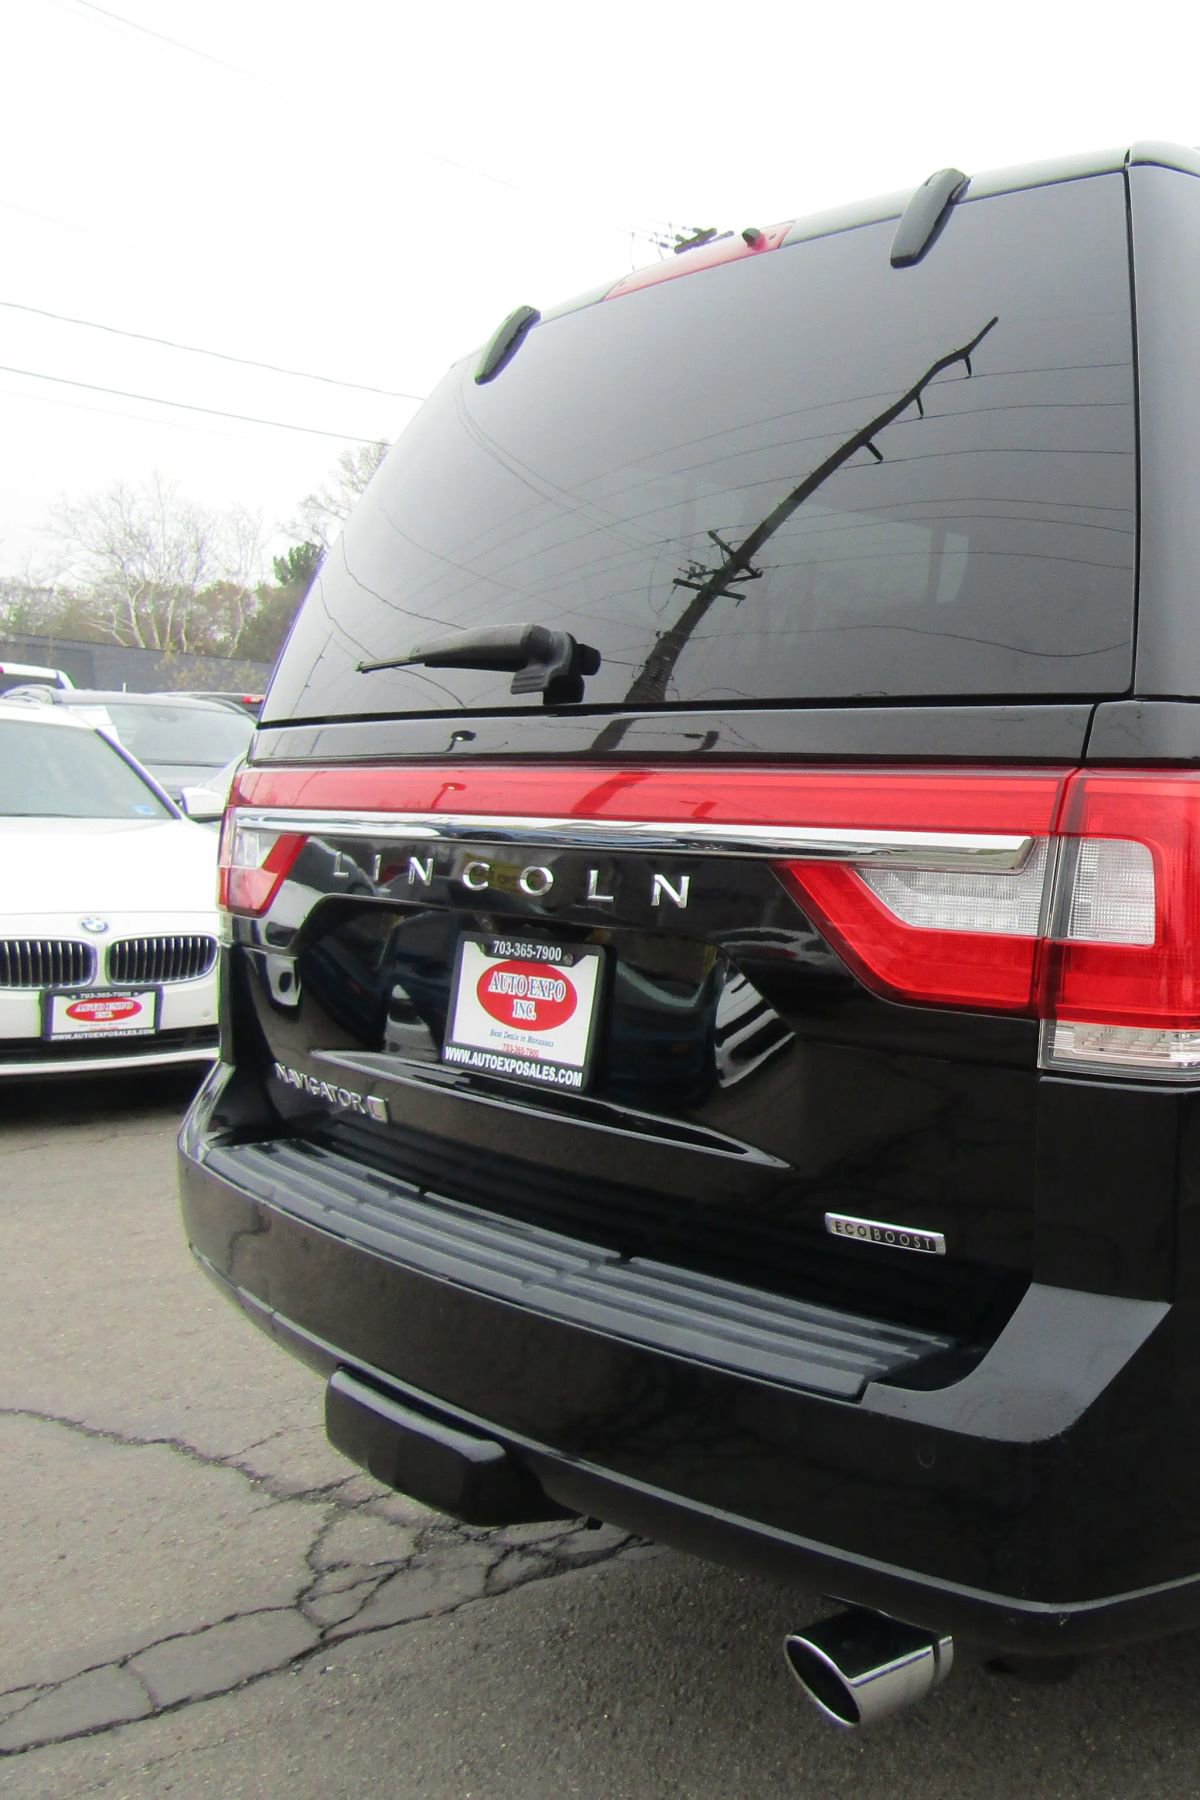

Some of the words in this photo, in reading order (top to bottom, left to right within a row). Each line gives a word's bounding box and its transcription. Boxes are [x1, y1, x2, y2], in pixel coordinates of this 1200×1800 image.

[333, 851, 690, 909] LINCOLN
[493, 940, 562, 962] 703-365-7900
[488, 971, 528, 997] AUTO
[528, 976, 567, 1003] EXPO
[512, 1000, 537, 1020] INC.
[445, 1046, 583, 1088] WWW.AUTOEXPOSALES.COM
[834, 1220, 933, 1250] ECOBOOST
